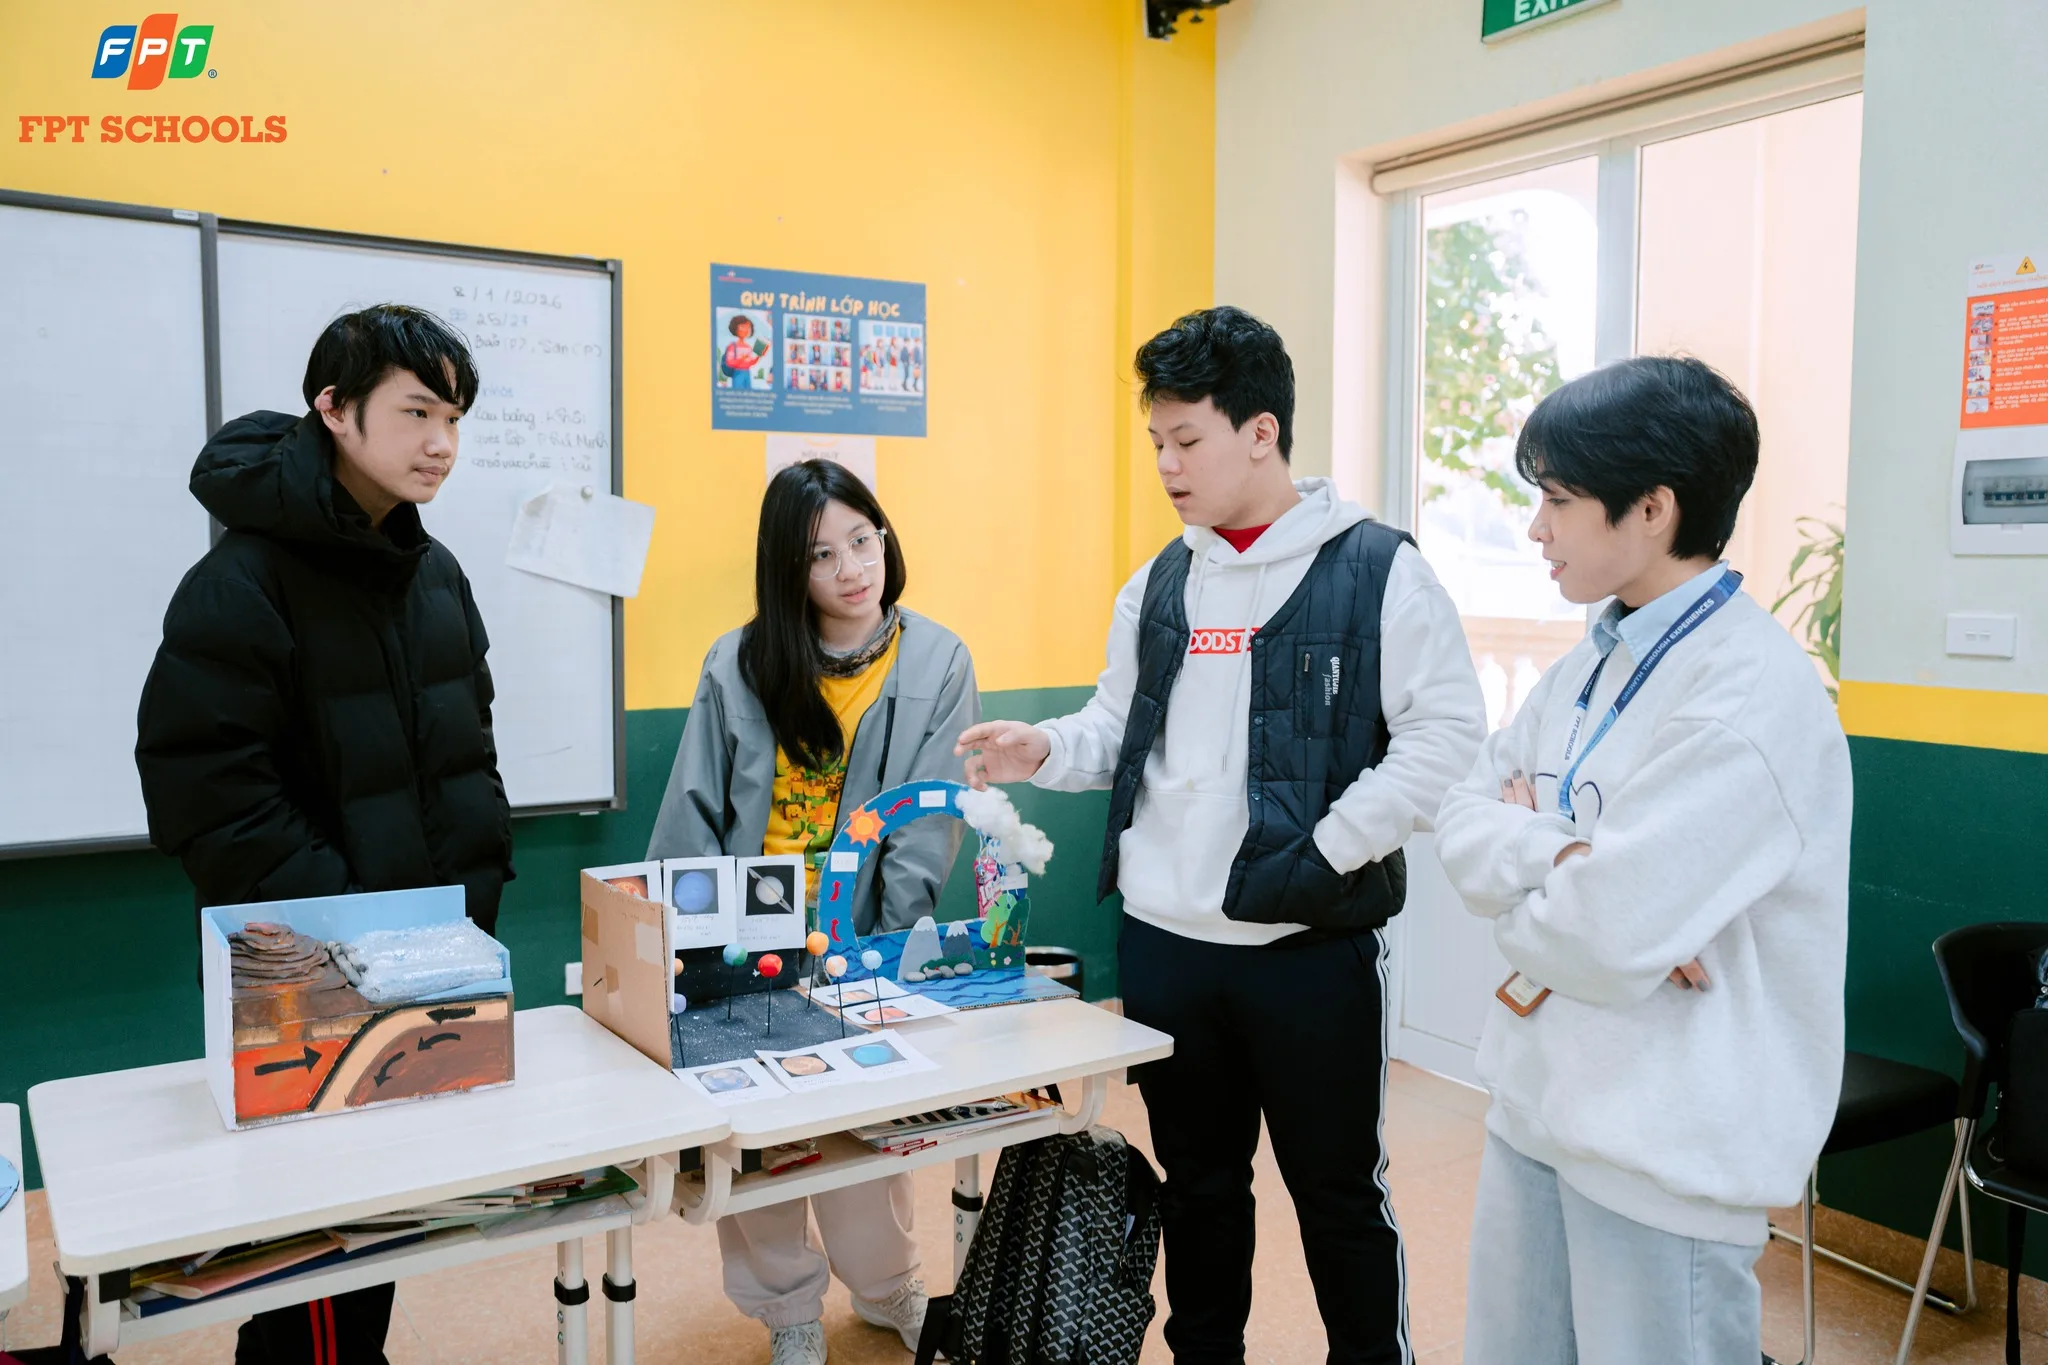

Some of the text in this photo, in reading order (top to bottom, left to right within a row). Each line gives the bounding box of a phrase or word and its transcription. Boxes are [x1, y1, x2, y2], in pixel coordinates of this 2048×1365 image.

[1514, 0, 1569, 23] EX
[740, 291, 775, 308] QUY
[830, 295, 864, 316] LỚP
[867, 300, 900, 320] HỌC
[1621, 598, 1715, 702] GROWTH THROUGH EXPERIENCES
[1321, 673, 1331, 706] fashion
